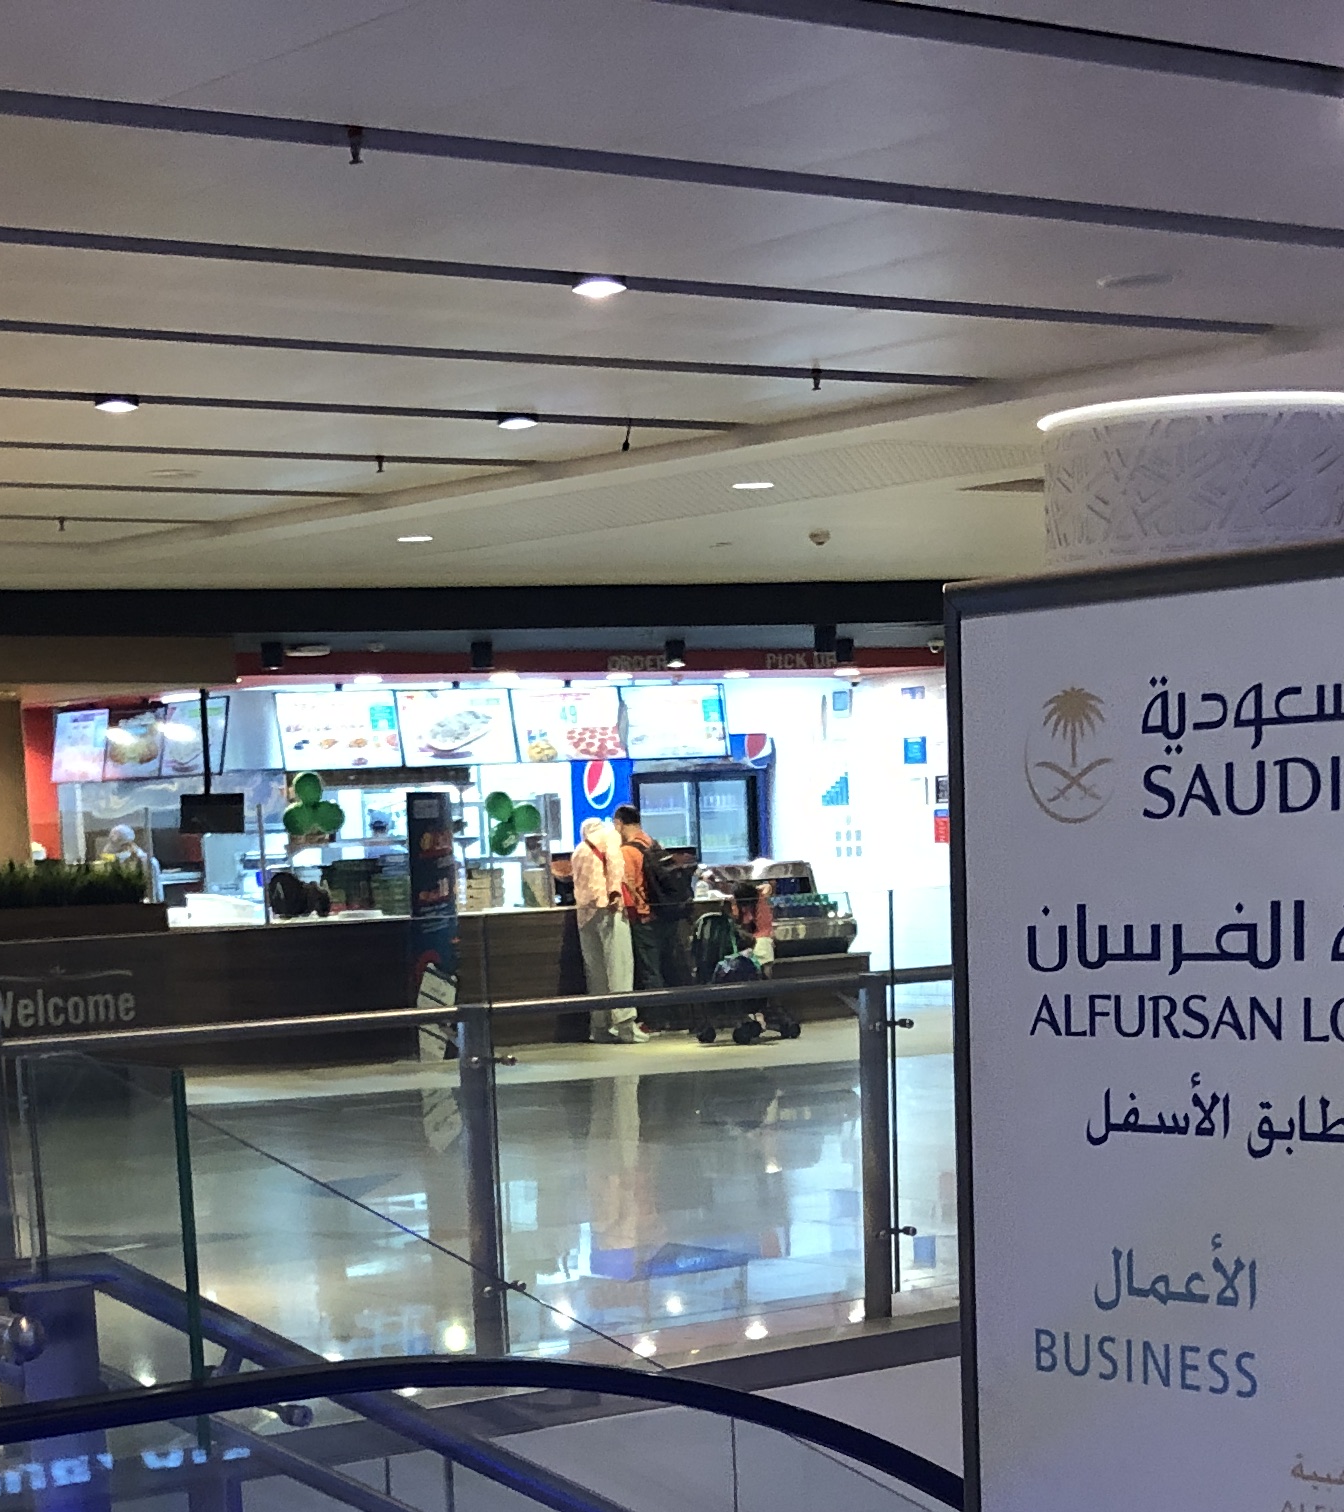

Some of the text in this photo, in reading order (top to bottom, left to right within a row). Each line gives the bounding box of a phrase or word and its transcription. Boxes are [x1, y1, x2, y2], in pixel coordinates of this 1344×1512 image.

[1027, 899, 1305, 976] الفرسان
[1030, 993, 1283, 1042] ALFURSAN
[1086, 1071, 1231, 1147] الأسفل
[1094, 1232, 1258, 1311] الأعمال
[1034, 1327, 1258, 1399] BUSINESS
